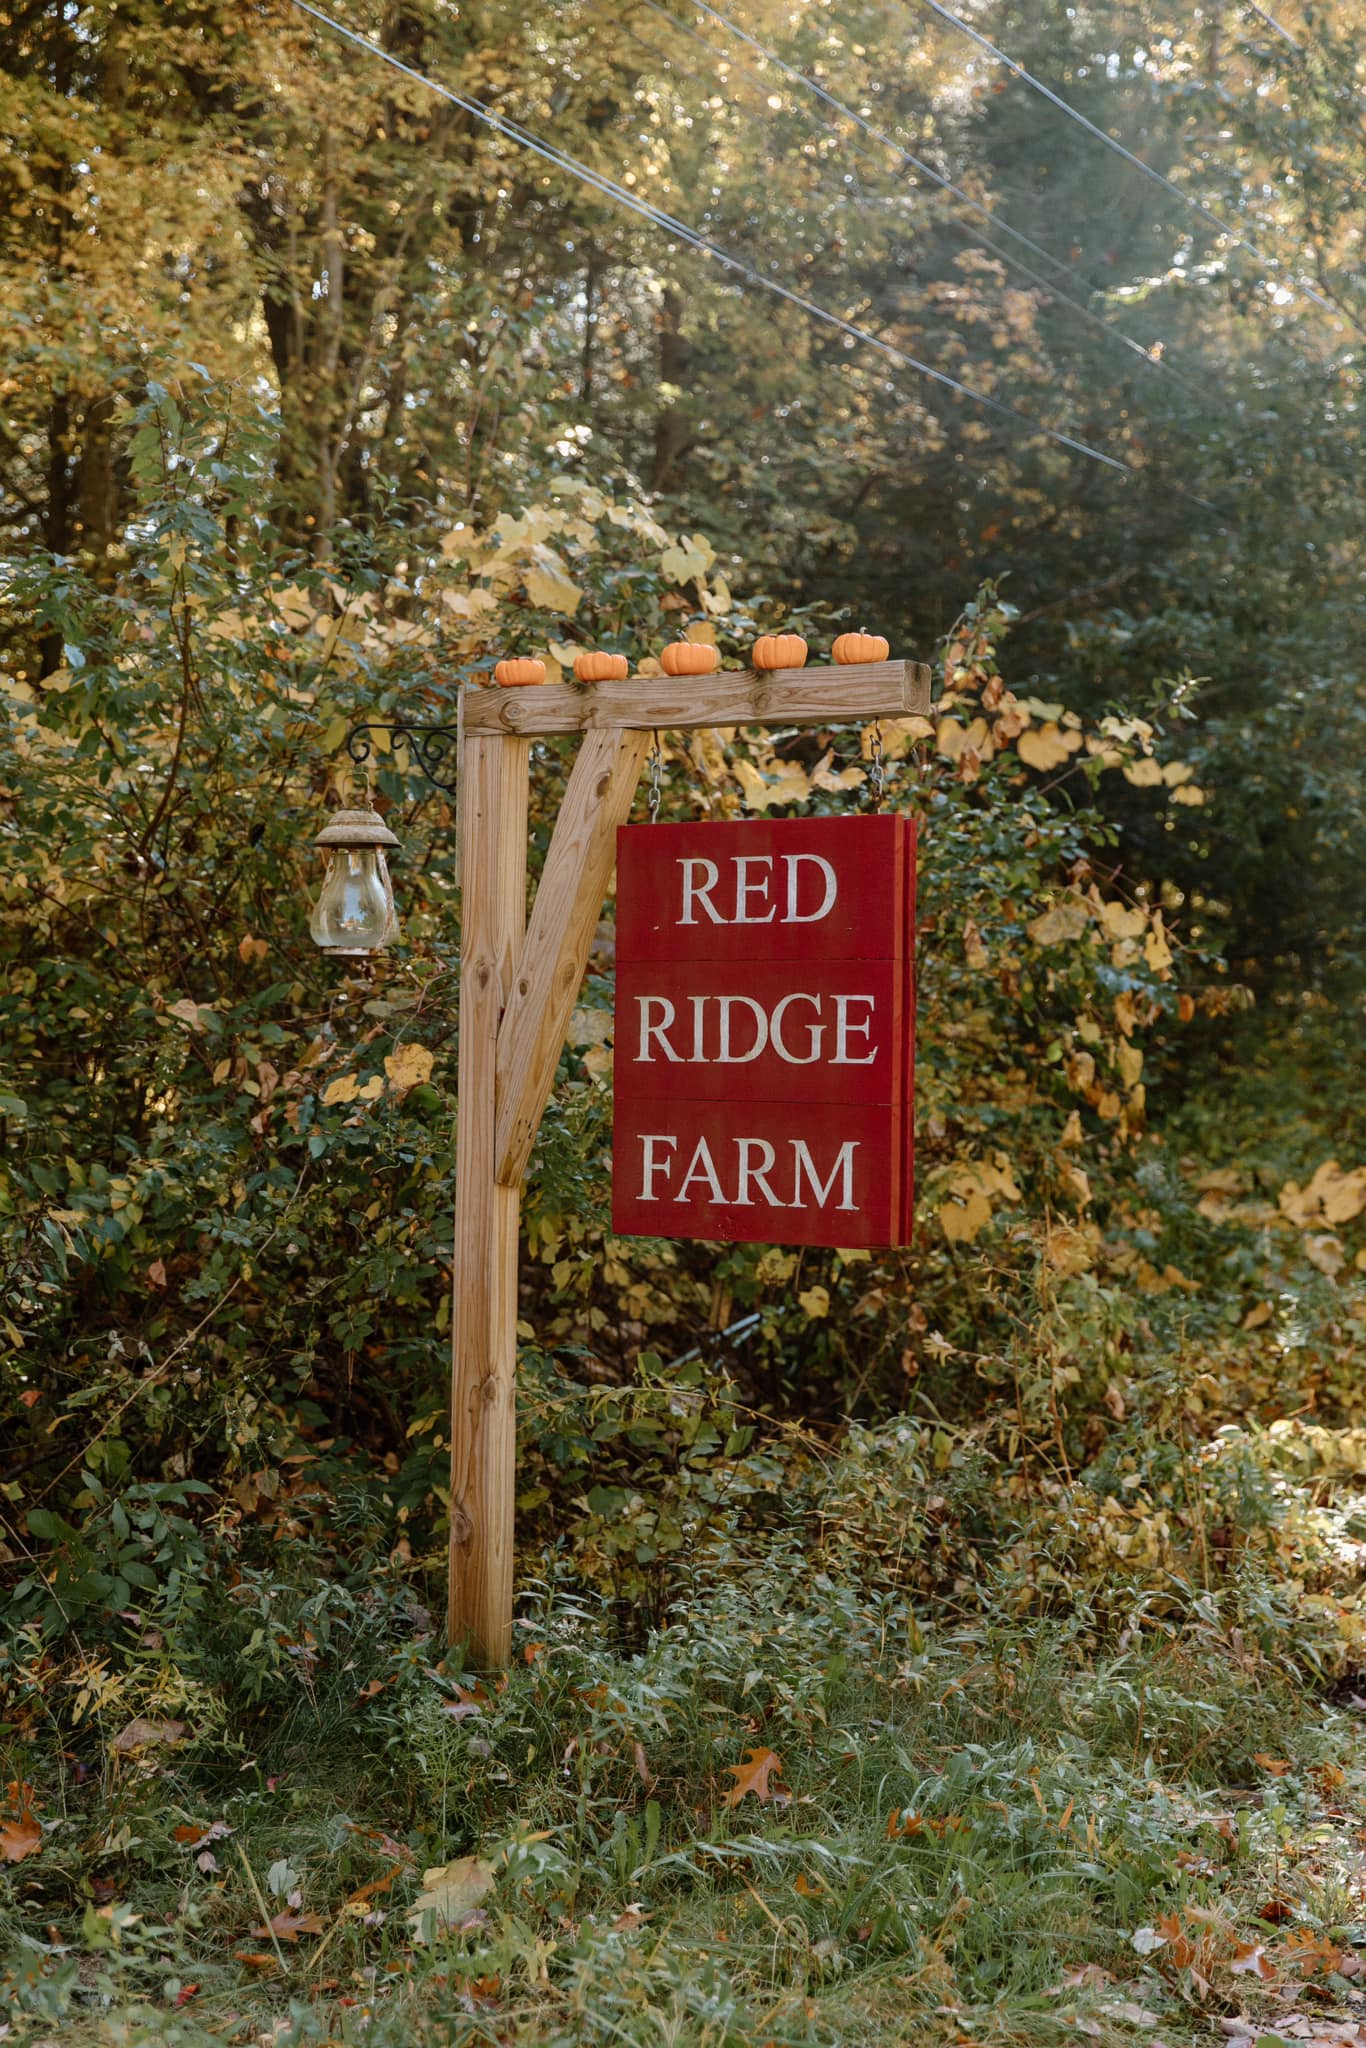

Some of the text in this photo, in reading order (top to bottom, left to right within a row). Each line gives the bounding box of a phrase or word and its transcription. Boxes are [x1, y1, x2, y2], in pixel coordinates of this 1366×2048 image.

[675, 854, 838, 925] RED
[632, 993, 879, 1065] RIDGE
[635, 1134, 861, 1211] FARM
